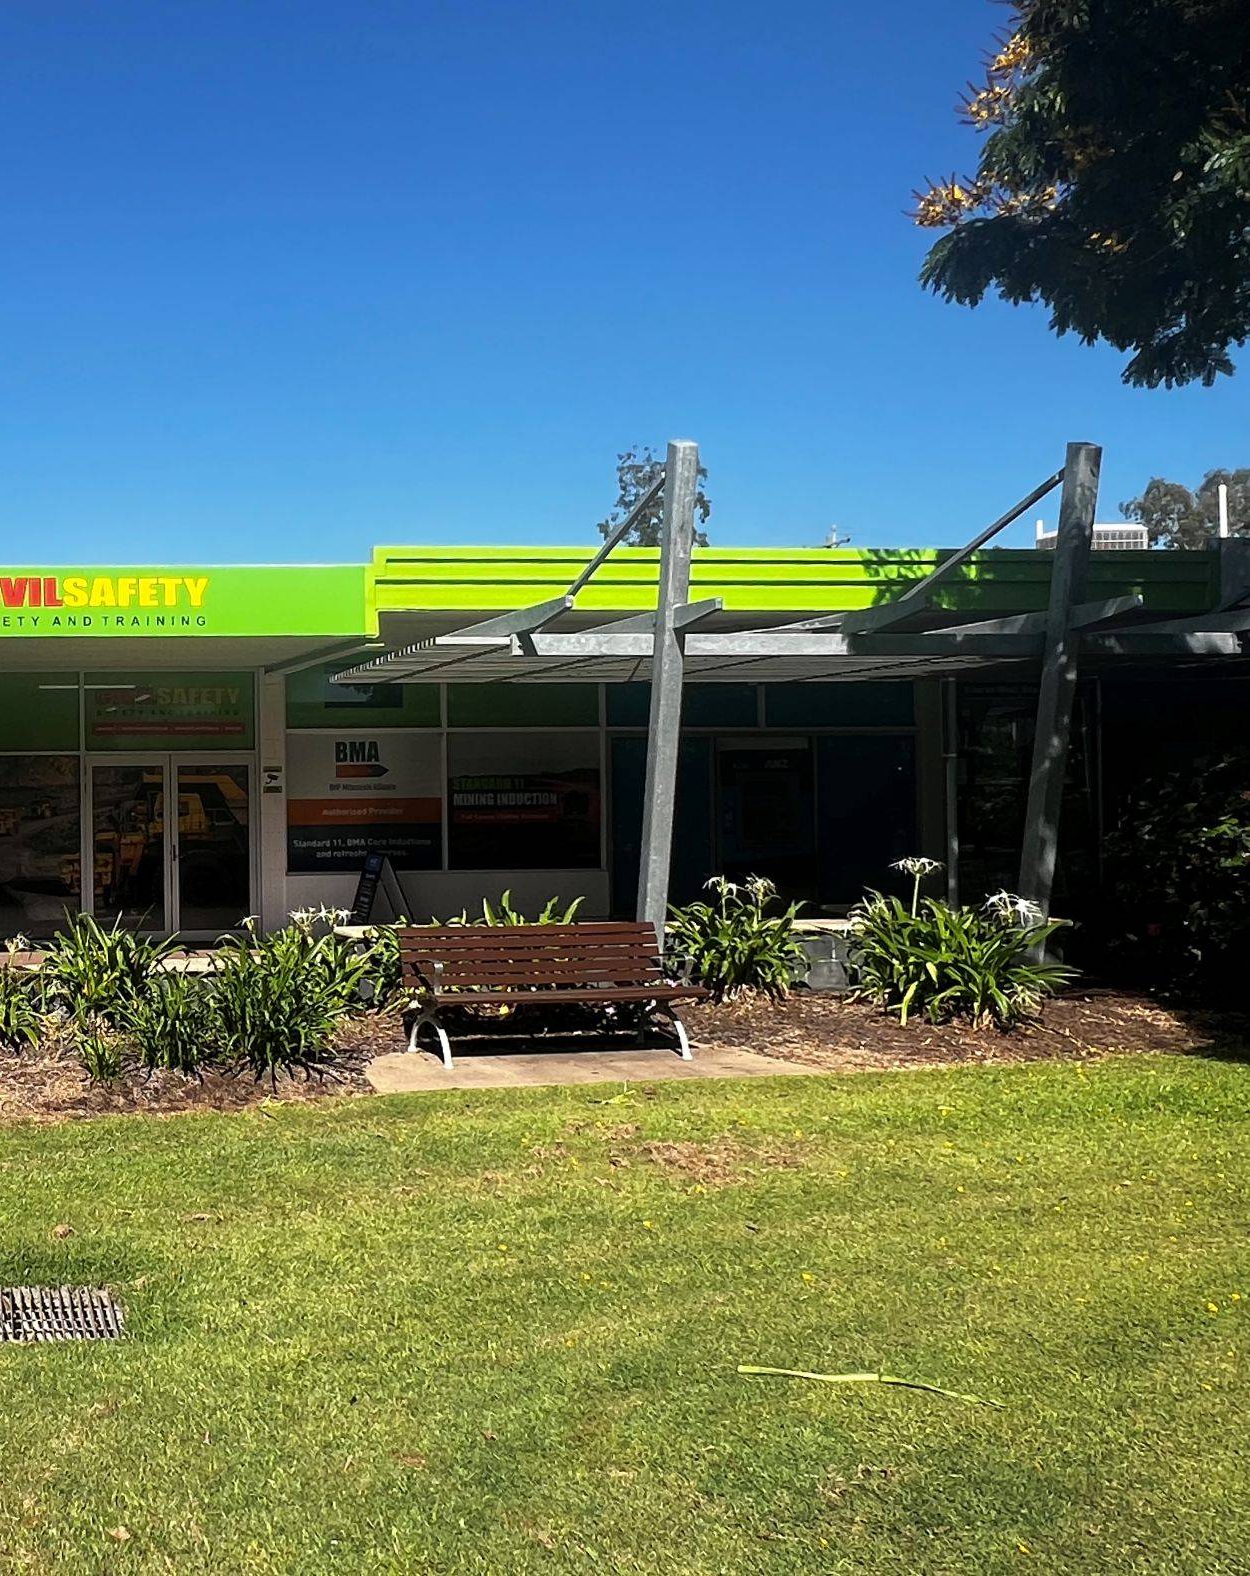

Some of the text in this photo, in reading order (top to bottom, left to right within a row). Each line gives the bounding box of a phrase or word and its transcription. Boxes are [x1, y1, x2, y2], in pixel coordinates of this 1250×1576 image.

[52, 616, 92, 627] AND
[102, 616, 207, 627] TRAINING
[335, 741, 379, 762] BMA
[453, 792, 558, 806] MINING INDUCTION
[293, 839, 331, 848] Standard
[347, 838, 365, 847] BMA
[316, 850, 332, 859] and
